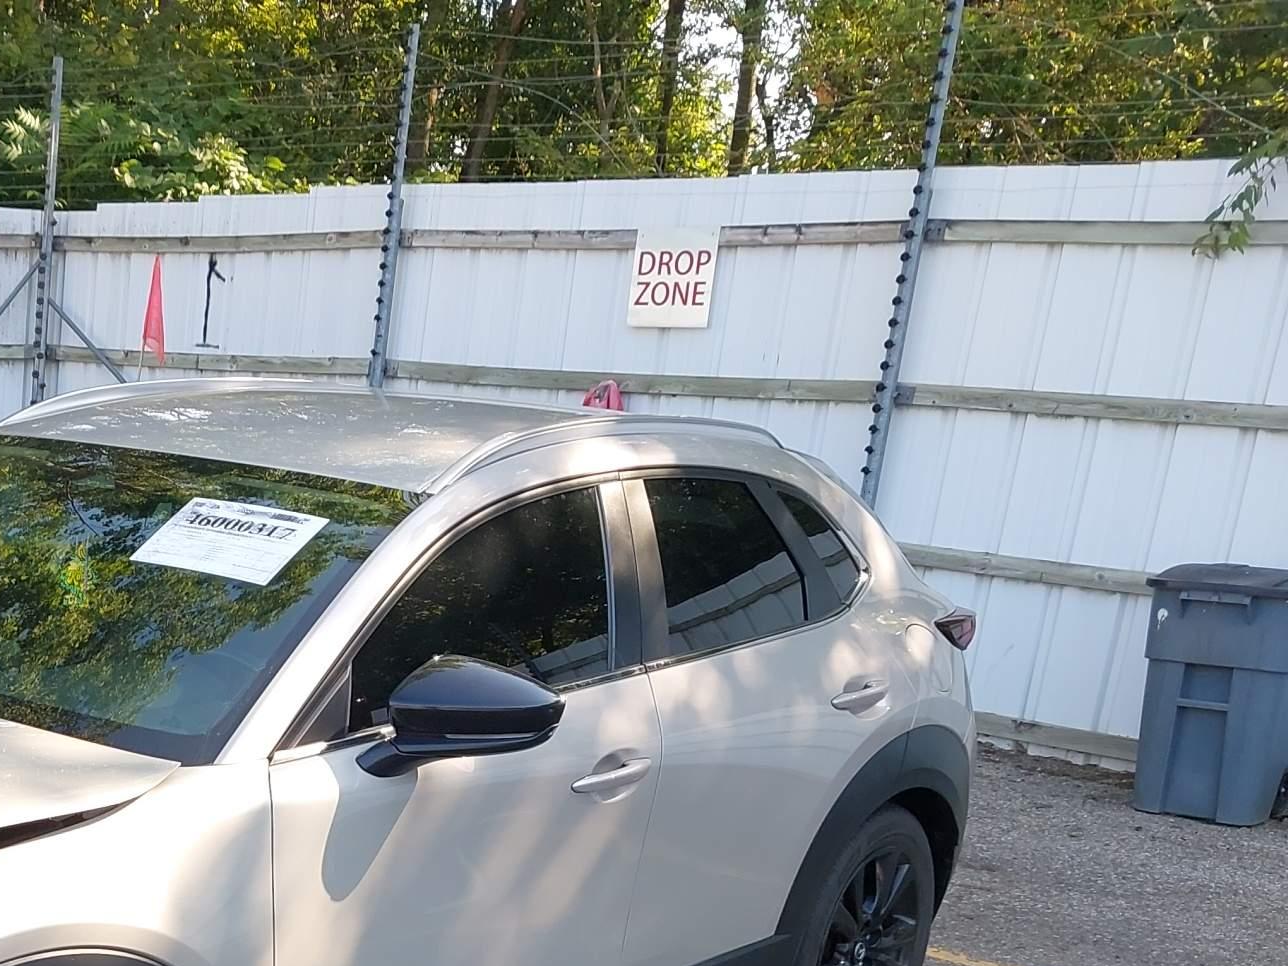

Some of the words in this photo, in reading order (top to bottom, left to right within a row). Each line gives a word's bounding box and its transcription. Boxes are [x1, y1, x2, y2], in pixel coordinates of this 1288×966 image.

[638, 250, 712, 276] DROP
[633, 281, 707, 306] ZONE
[185, 511, 297, 540] 46000317
